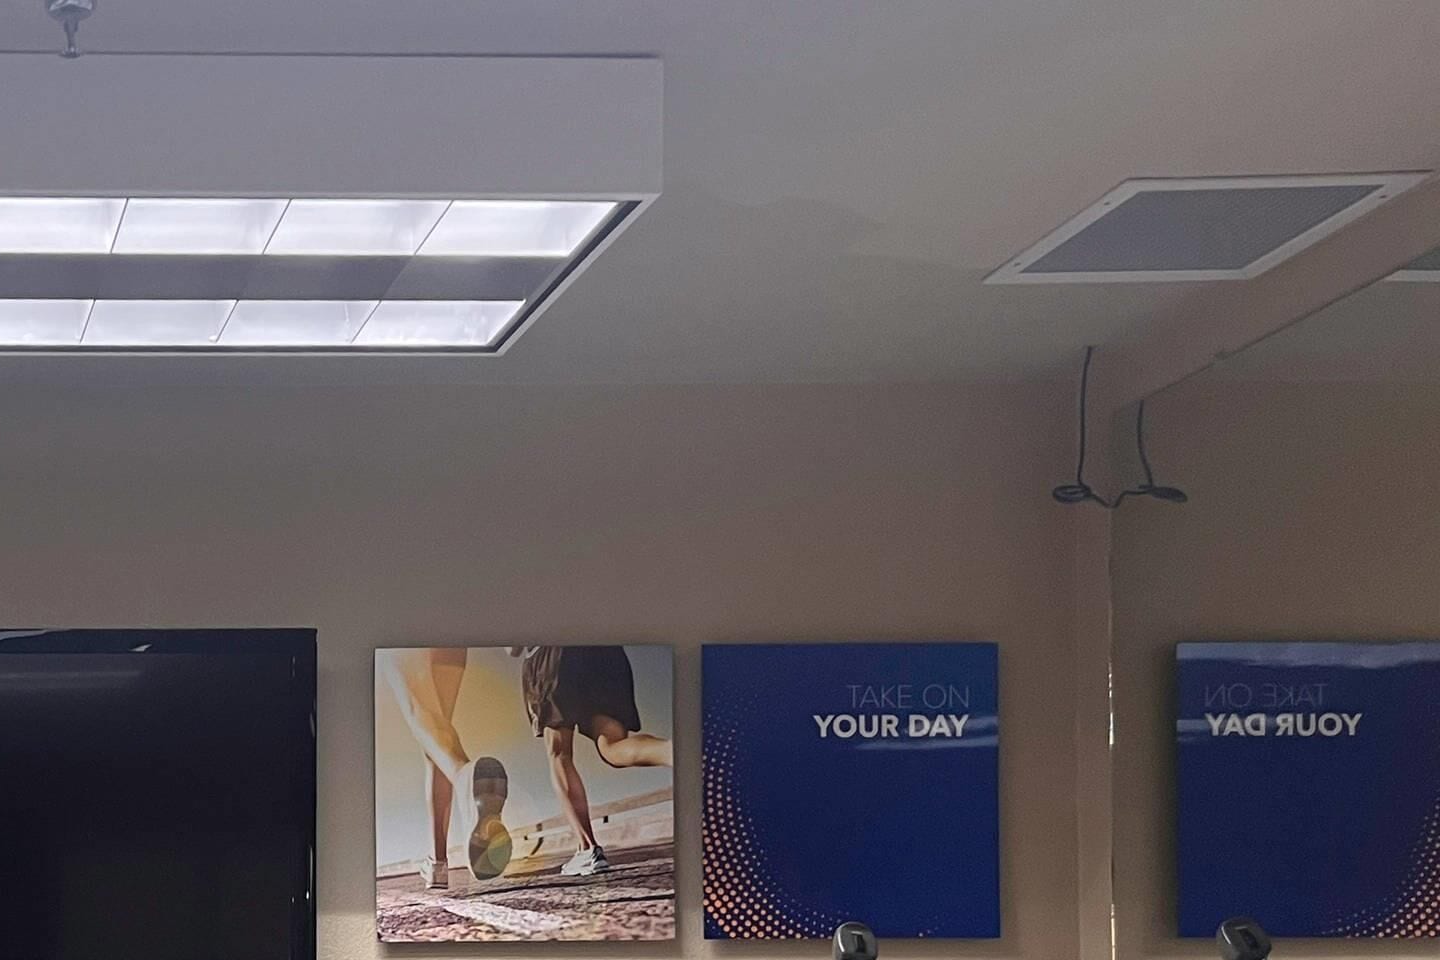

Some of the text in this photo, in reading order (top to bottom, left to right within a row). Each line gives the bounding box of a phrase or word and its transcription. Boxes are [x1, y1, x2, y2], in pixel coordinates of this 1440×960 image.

[846, 683, 969, 710] TAKE ON
[813, 714, 969, 738] YOUR DAY
